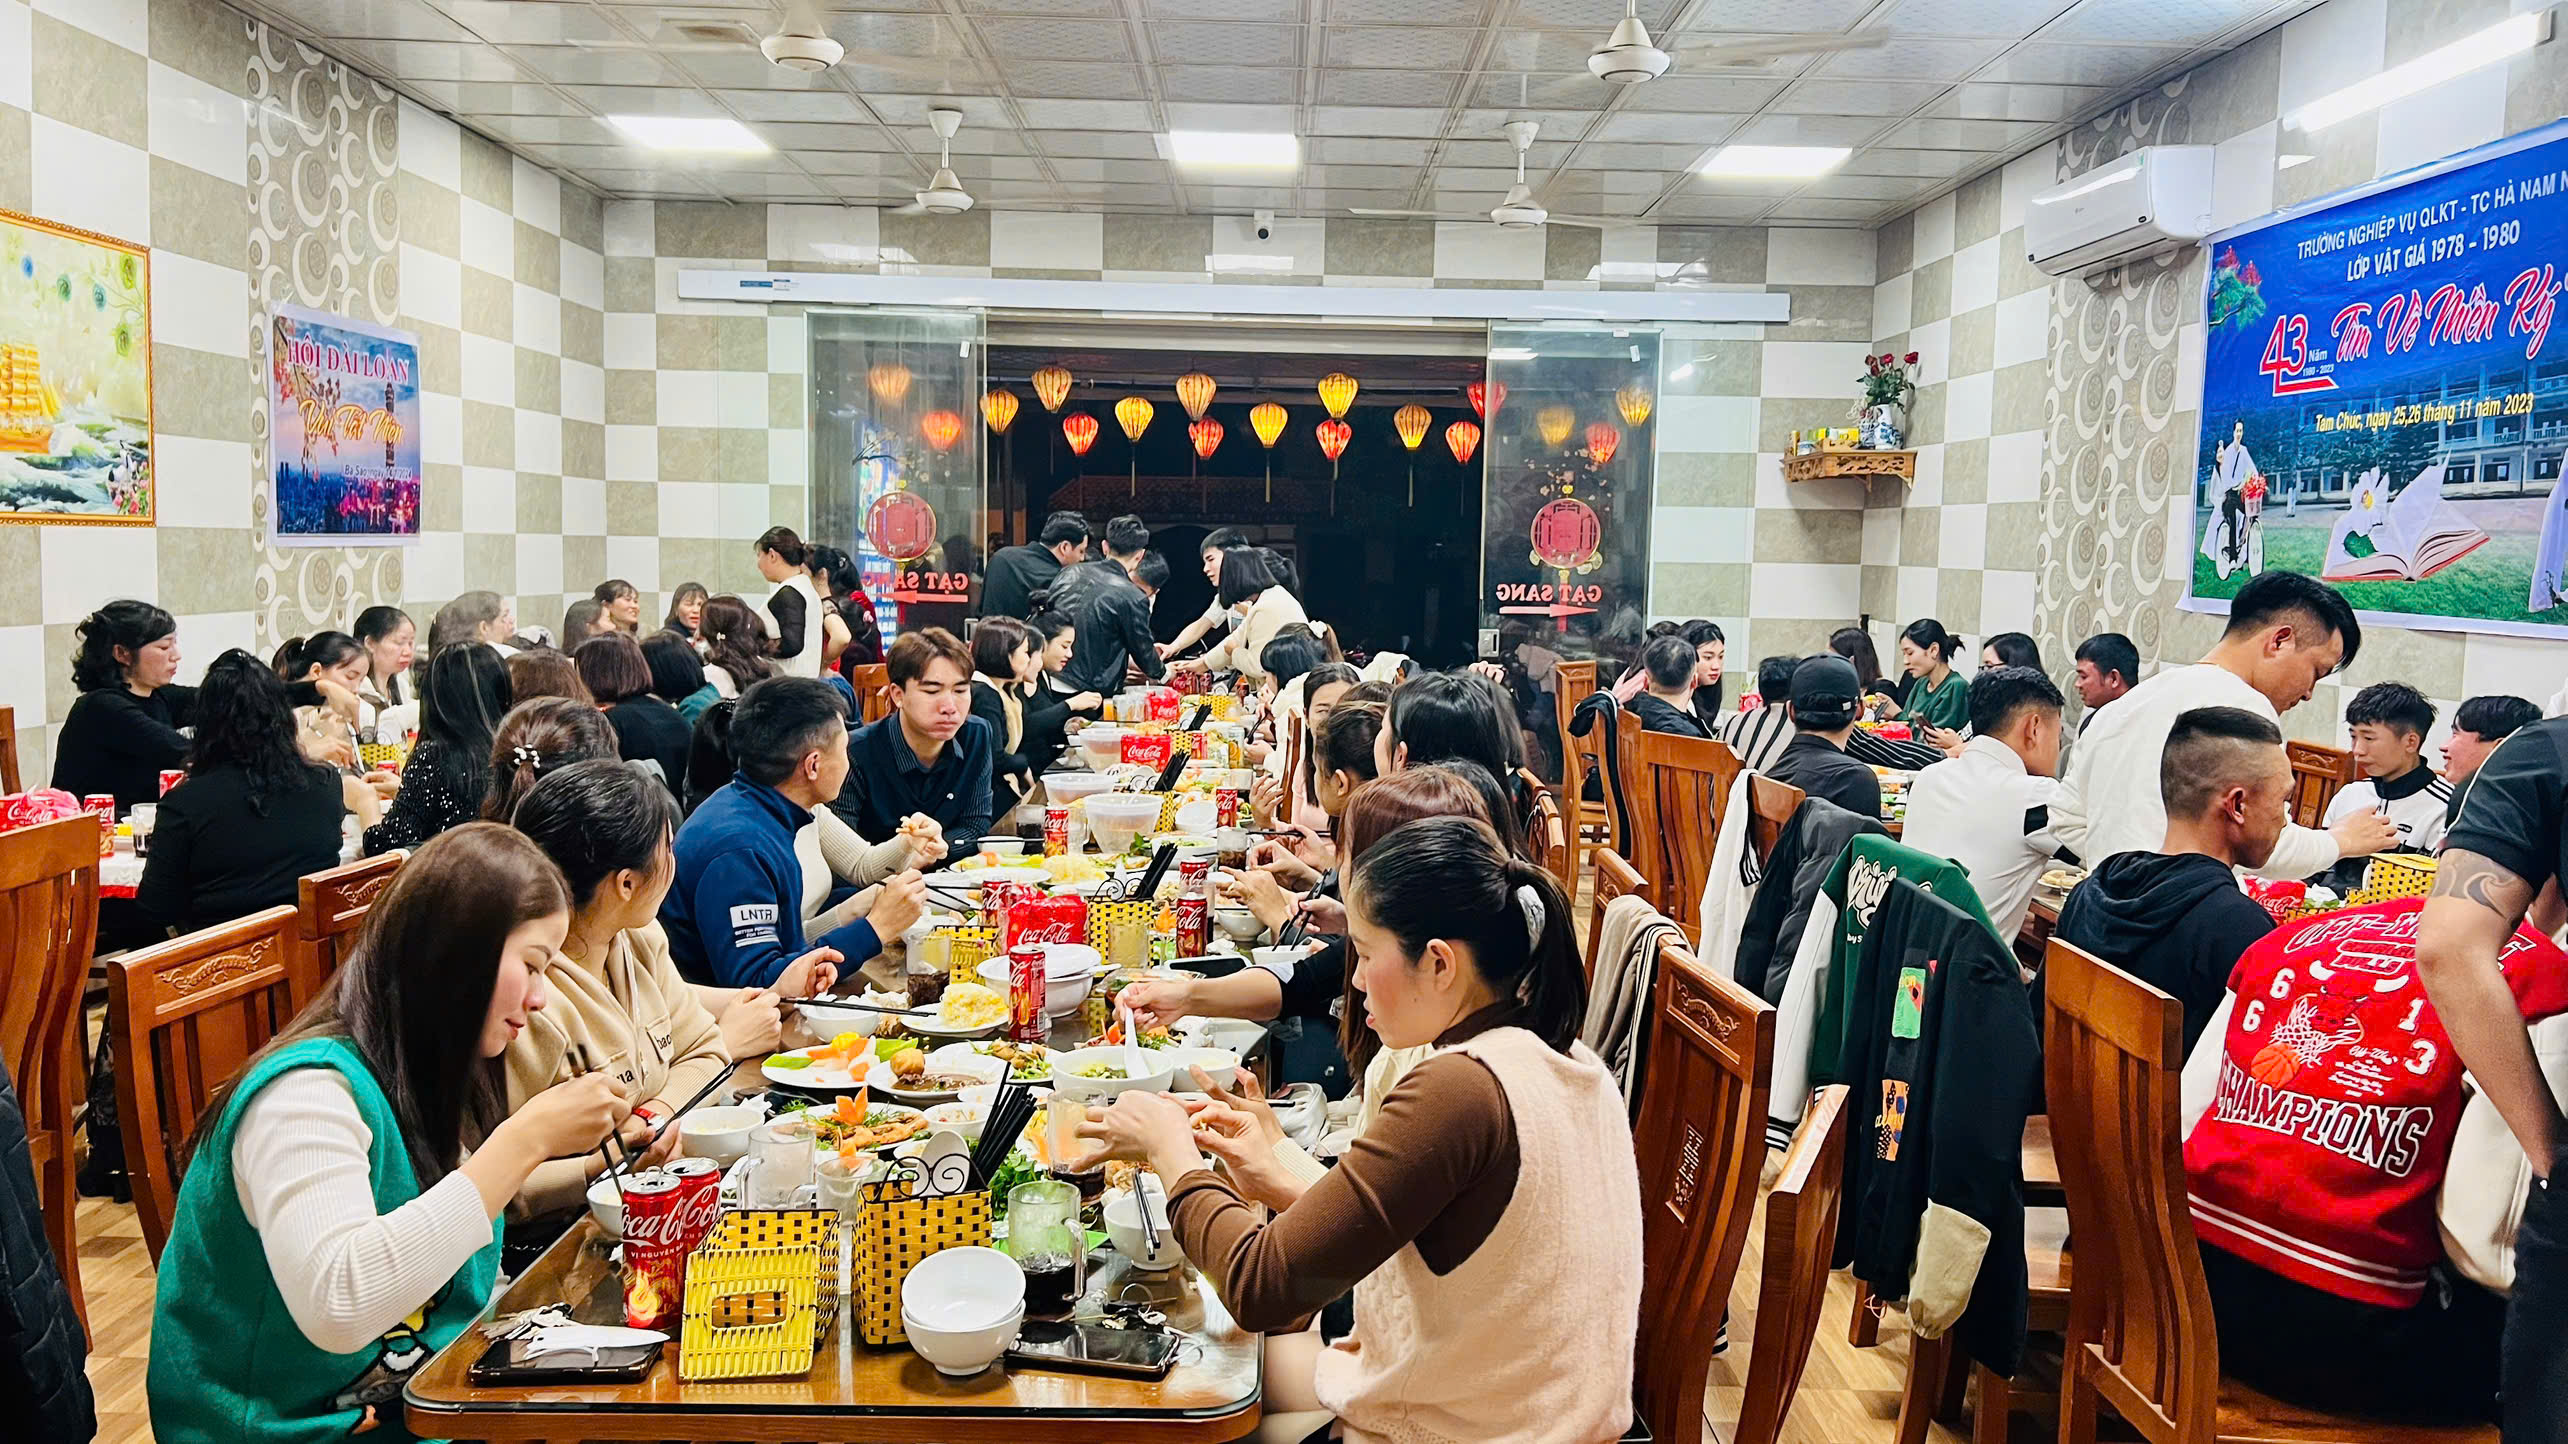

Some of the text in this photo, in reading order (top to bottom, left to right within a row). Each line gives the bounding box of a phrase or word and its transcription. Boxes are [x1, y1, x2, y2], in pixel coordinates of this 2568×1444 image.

[2298, 229, 2345, 260] TRƯỜNG
[2348, 215, 2396, 247] NGHIỆP
[2399, 211, 2417, 235] VỤ
[2420, 200, 2459, 228] QLKT
[2470, 193, 2490, 214] TC
[2494, 179, 2516, 209] HÀ
[2519, 172, 2557, 202] NAM
[2347, 250, 2371, 282] LỚP
[2374, 246, 2402, 278] VẬT
[2404, 237, 2426, 268] GIÁ
[2431, 233, 2465, 263] 1978
[2482, 219, 2521, 251] 1980
[286, 331, 322, 373] HỘI
[2259, 314, 2309, 397] 43
[2315, 391, 2535, 432] Tam Chúc, ngày 25,26 tháng 11 năm 2023
[2269, 967, 2296, 999] 6
[2242, 999, 2265, 1032] 6
[2397, 997, 2425, 1035] 1
[2405, 1038, 2439, 1075] 3
